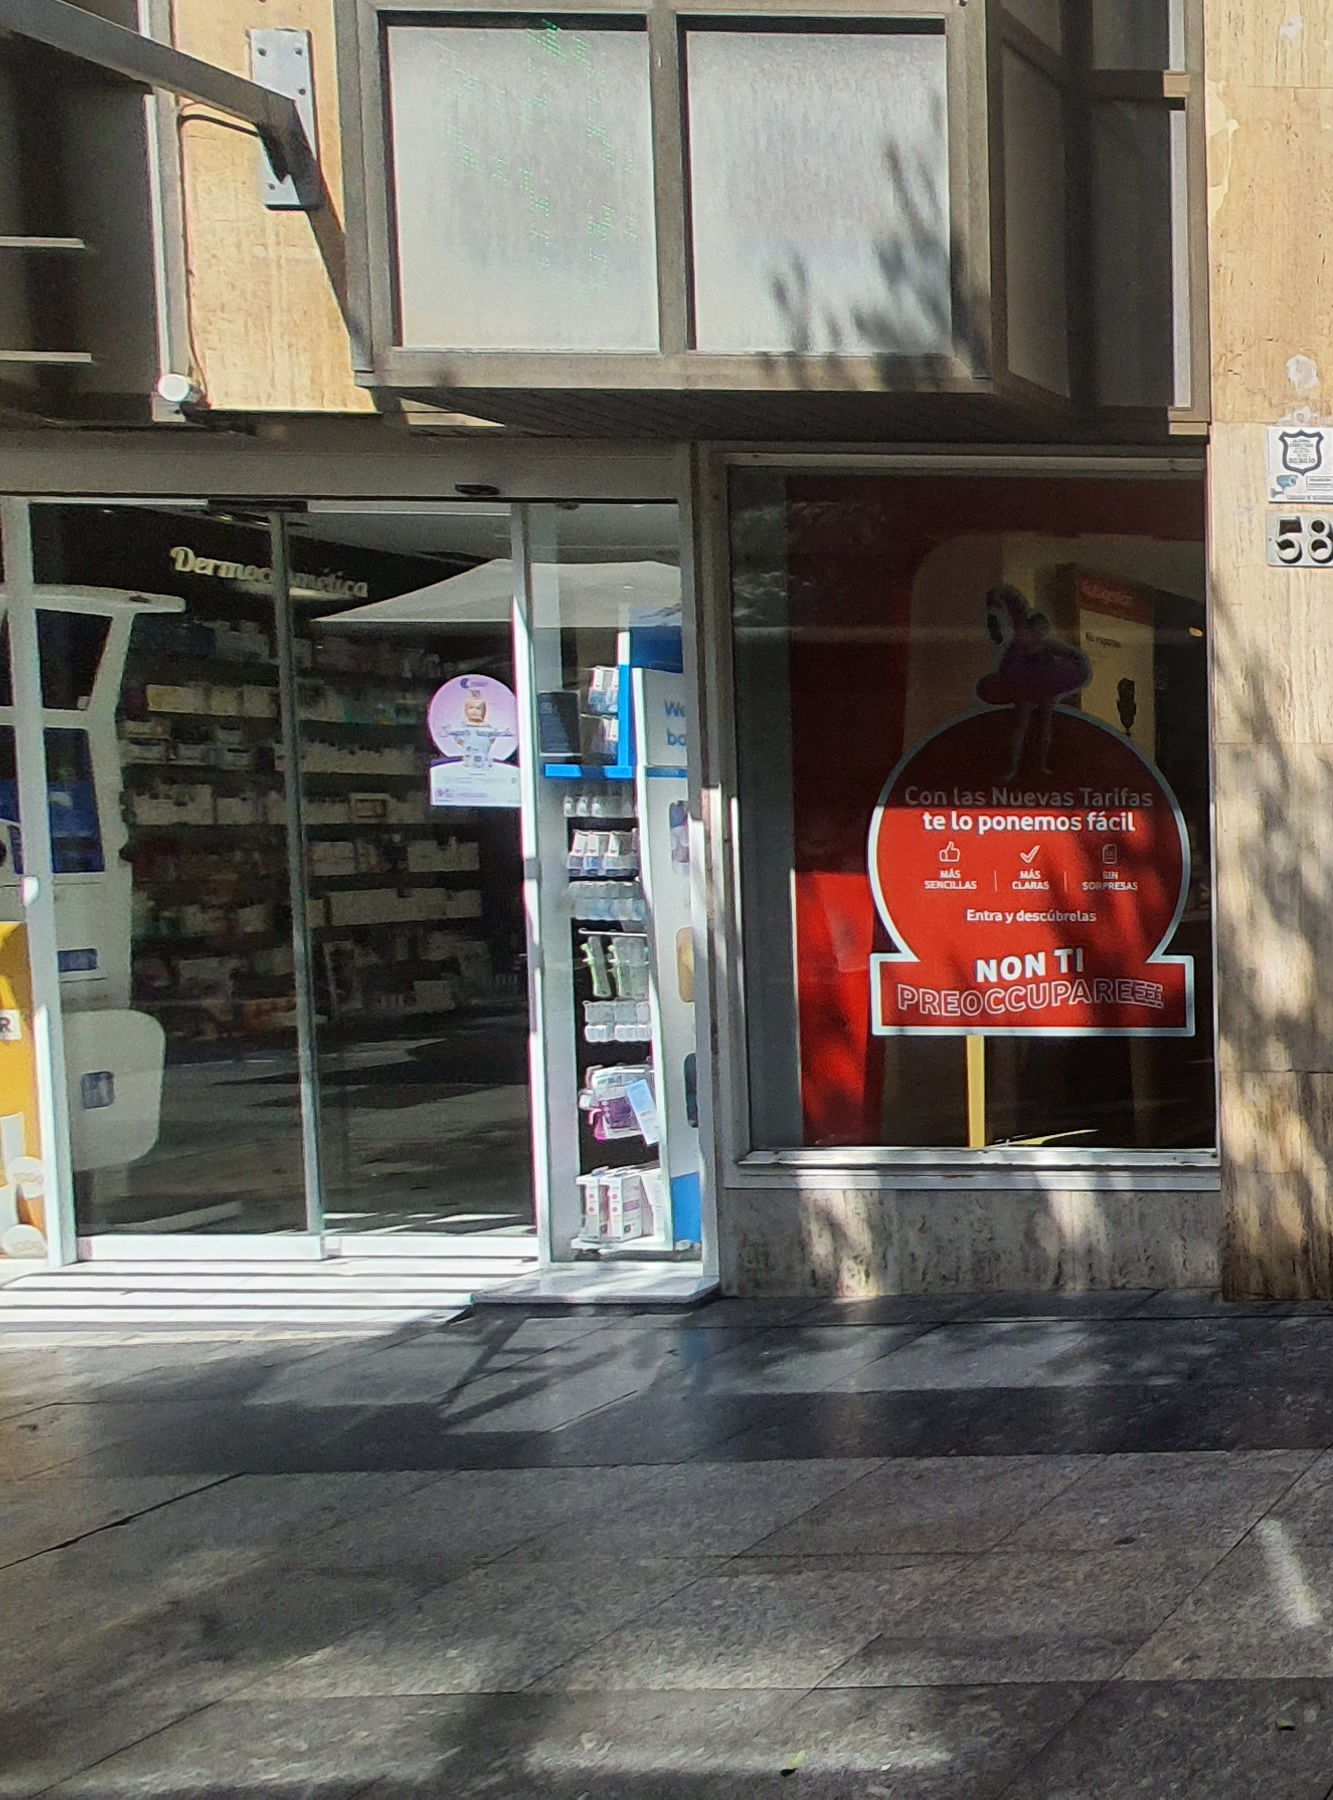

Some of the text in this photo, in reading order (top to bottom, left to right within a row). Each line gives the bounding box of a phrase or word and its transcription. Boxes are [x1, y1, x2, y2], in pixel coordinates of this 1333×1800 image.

[904, 787, 1153, 807] Con las Nuevas Tarifas
[923, 811, 1135, 834] te lo ponemos fácil
[940, 869, 1118, 880] MÁS MÁS SIN
[924, 881, 1138, 891] SENCILLAS CLARAS SORPRESAS
[966, 909, 1097, 924] Entra y descúbrelas
[976, 948, 1083, 983] NON TI
